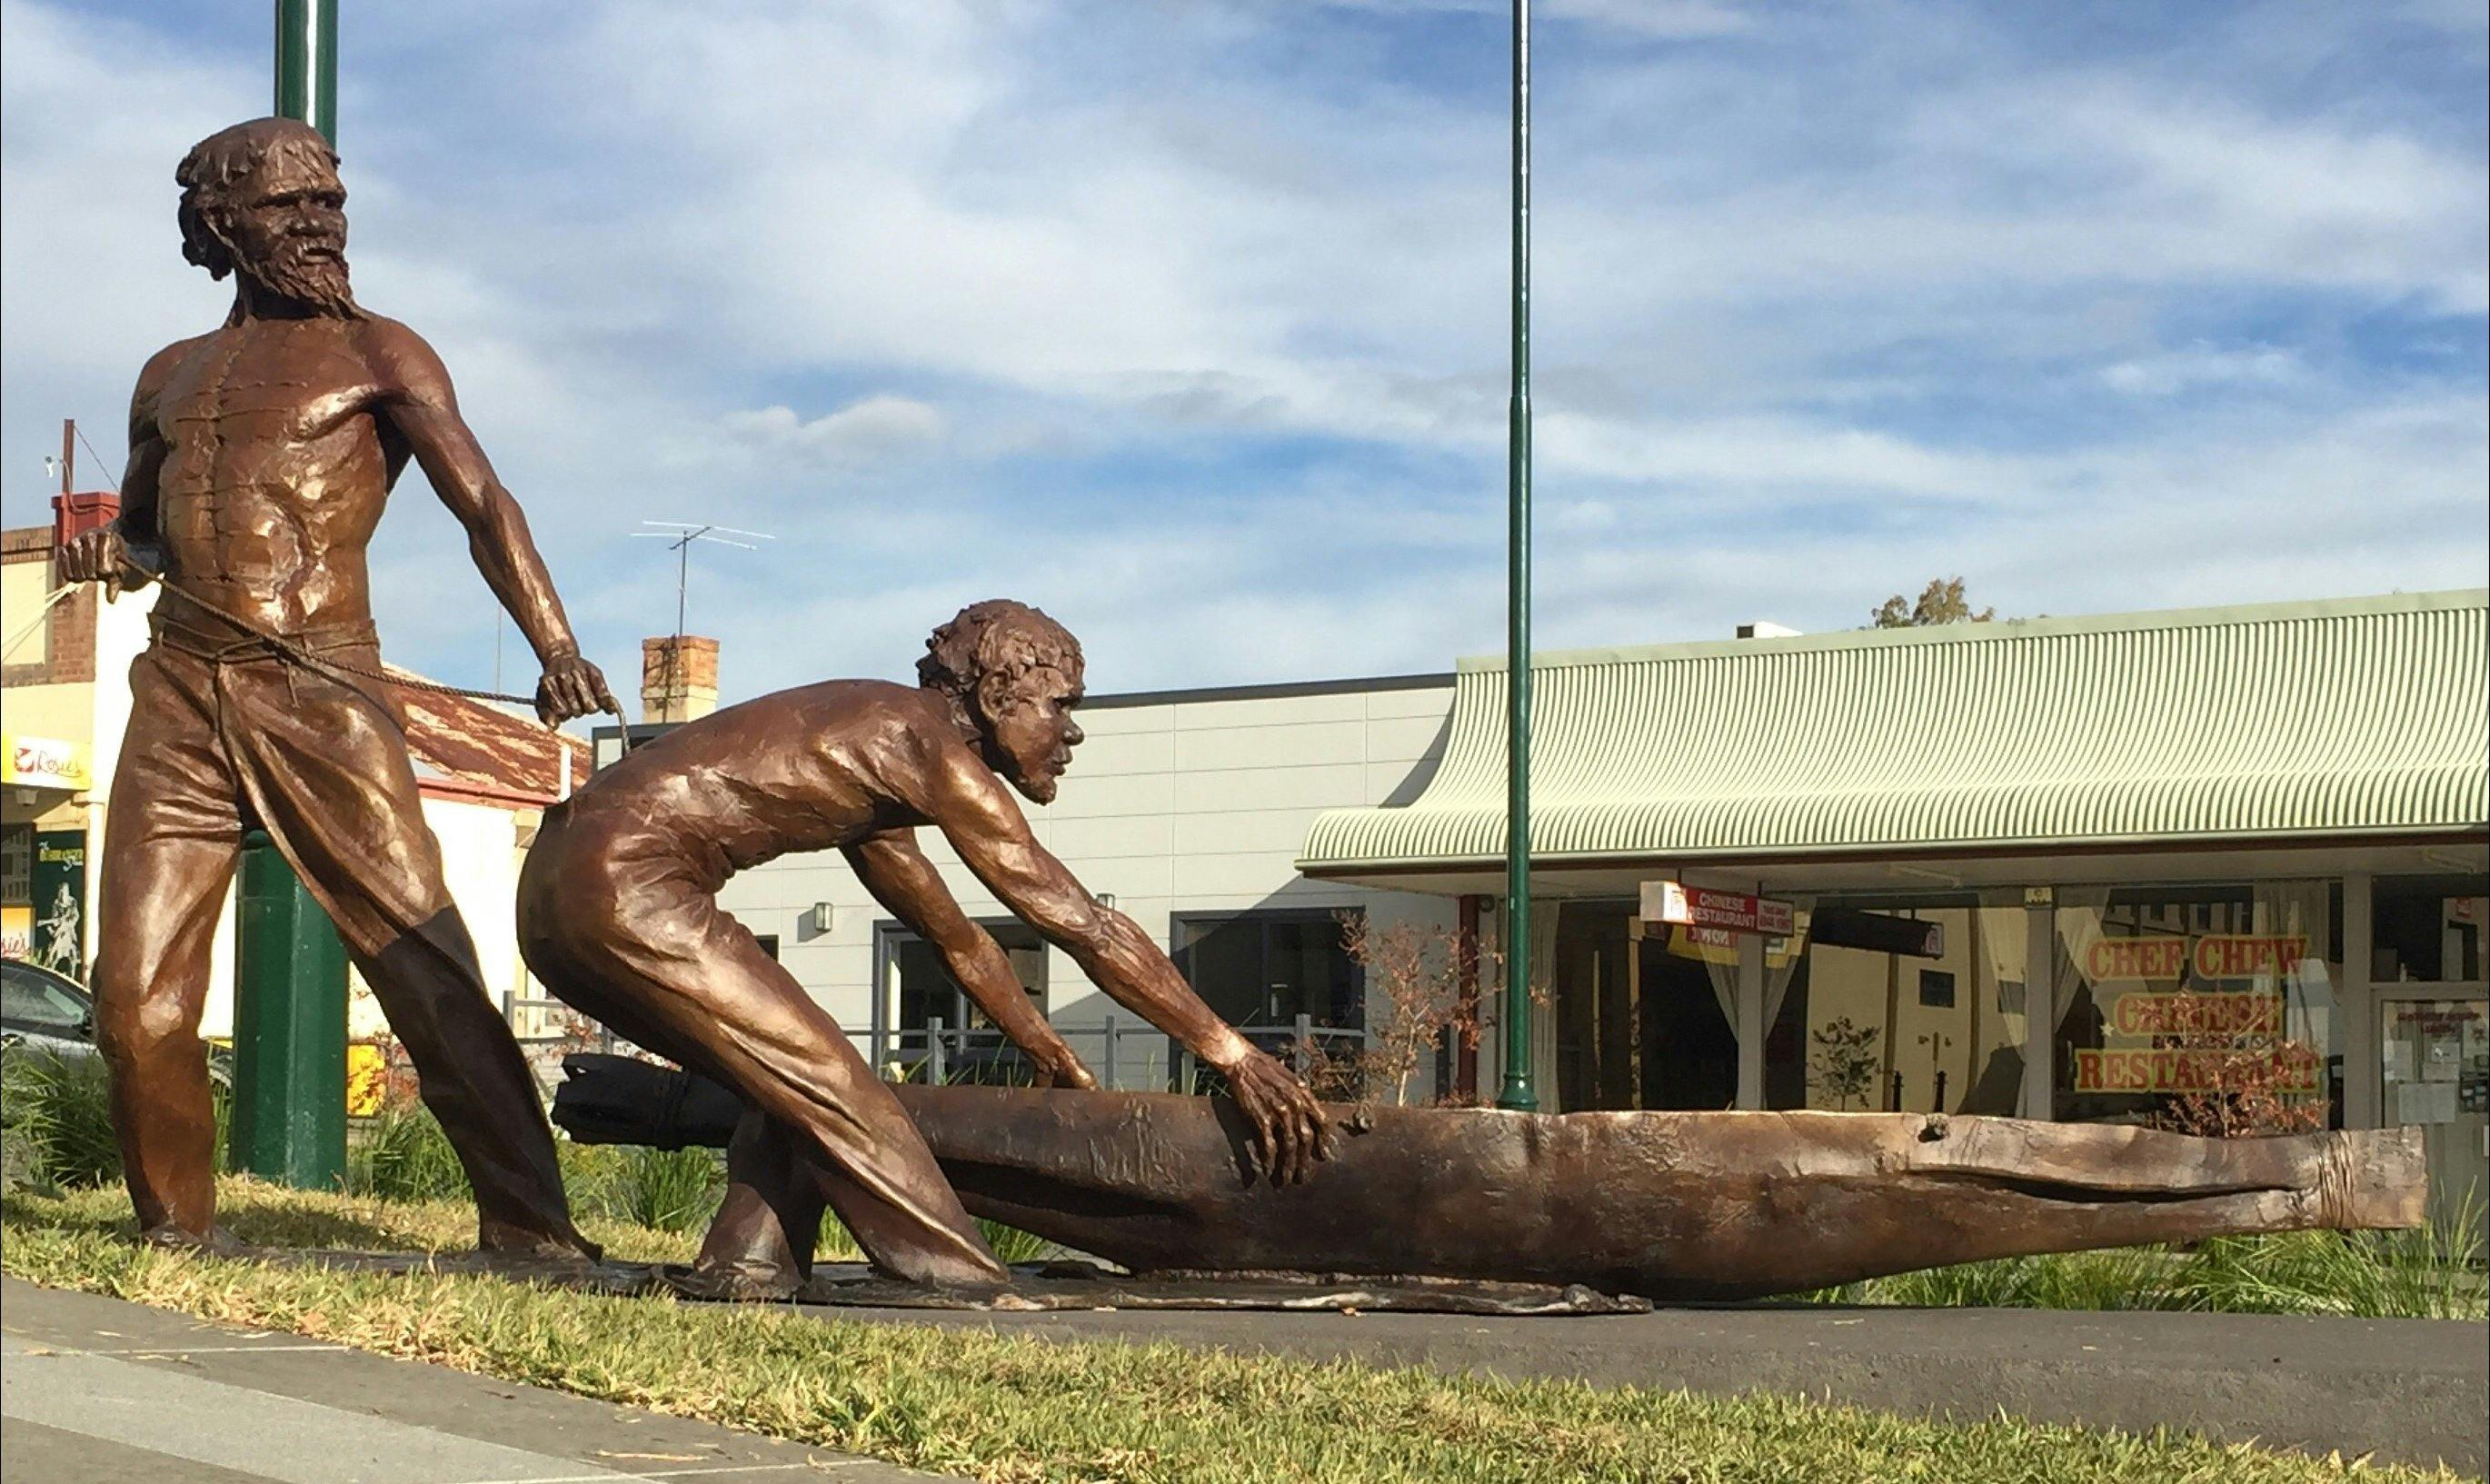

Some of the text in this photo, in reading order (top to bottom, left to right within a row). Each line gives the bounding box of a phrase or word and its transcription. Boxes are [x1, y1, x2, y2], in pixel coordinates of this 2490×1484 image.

[1698, 891, 1747, 912] CHINESE
[2087, 936, 2307, 979] CHEF CHEW
[2077, 1051, 2316, 1089] RESTAANT
